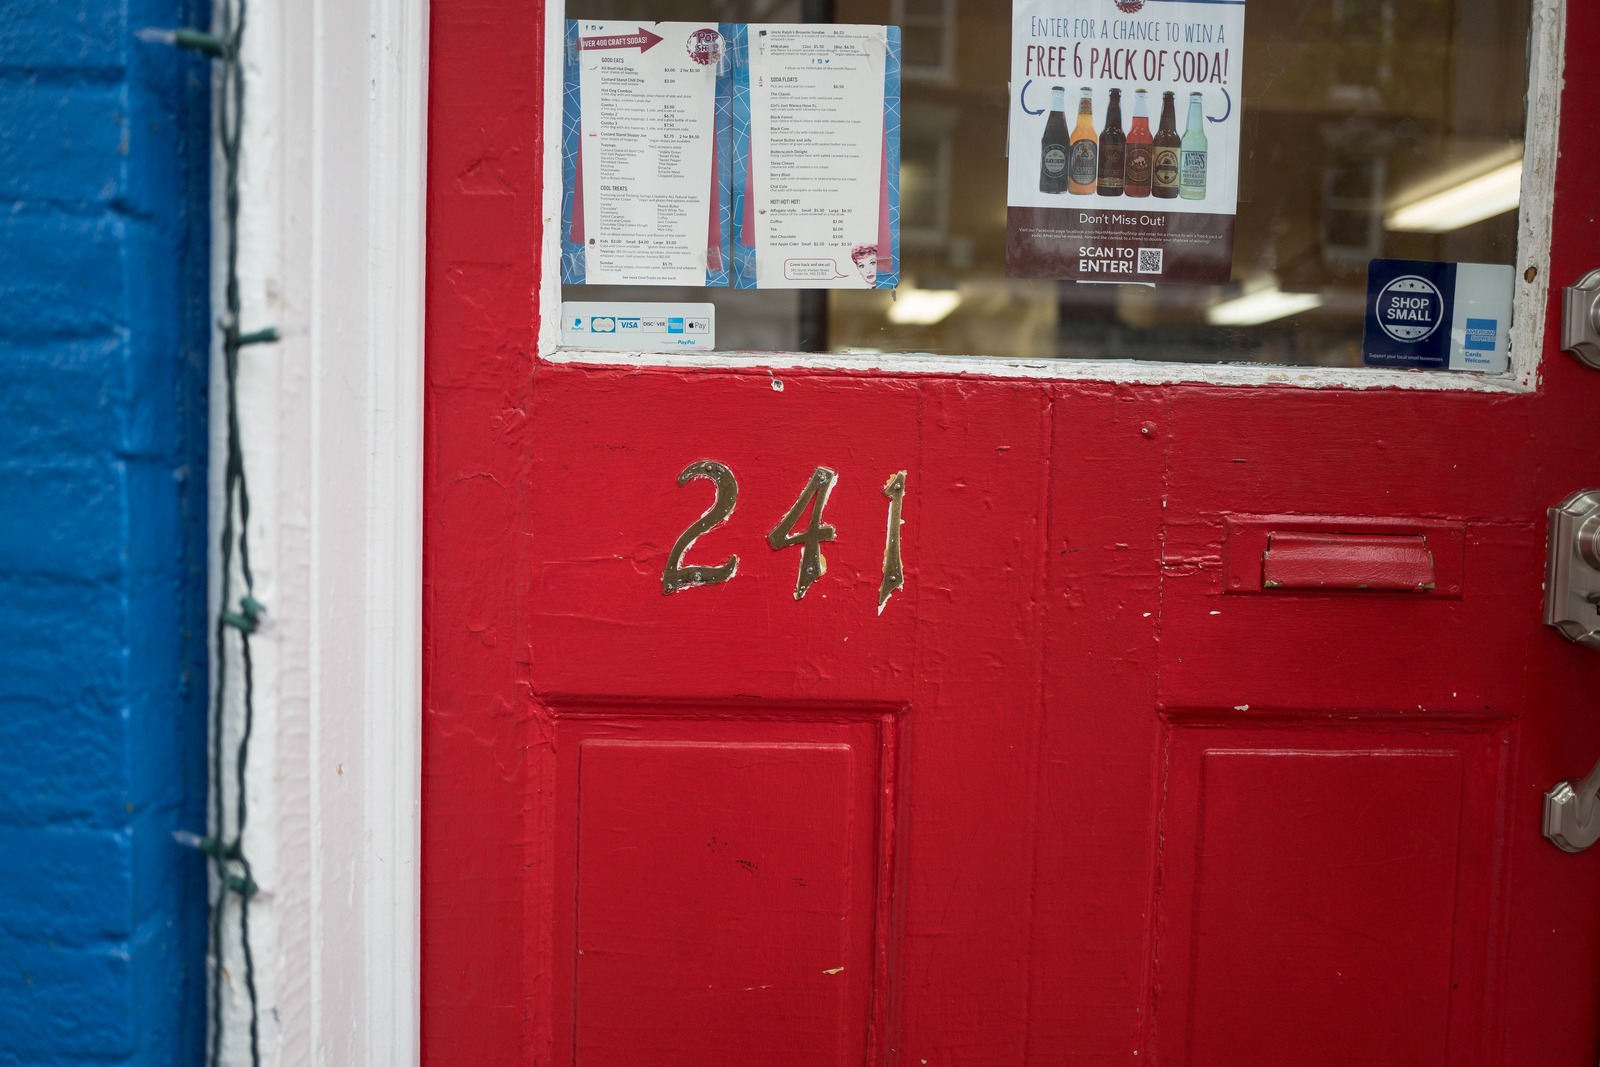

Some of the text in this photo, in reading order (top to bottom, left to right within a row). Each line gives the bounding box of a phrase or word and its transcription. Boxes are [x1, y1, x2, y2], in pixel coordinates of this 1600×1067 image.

[1074, 18, 1095, 39] FOR
[1100, 20, 1108, 39] A
[1113, 20, 1160, 42] CHANCE
[1165, 22, 1179, 43] TO
[1185, 23, 1212, 44] WIN
[1217, 24, 1224, 44] A
[597, 38, 607, 48] 400
[608, 37, 626, 47] CRAFT
[627, 36, 647, 46] SODAS!
[1026, 41, 1228, 85] FREE 6 PACK OF SODA!
[1079, 213, 1165, 227] Don't Miss Out!
[1079, 246, 1134, 259] SCAN TO
[1080, 259, 1133, 274] ENTER!
[1391, 296, 1430, 310] SHOP
[1386, 308, 1432, 322] SMALL
[620, 321, 639, 329] VISA
[694, 322, 706, 330] Pay
[1369, 352, 1386, 360] Support
[1386, 353, 1397, 361] your
[1465, 357, 1491, 365] Welcome
[662, 459, 906, 606] 241
